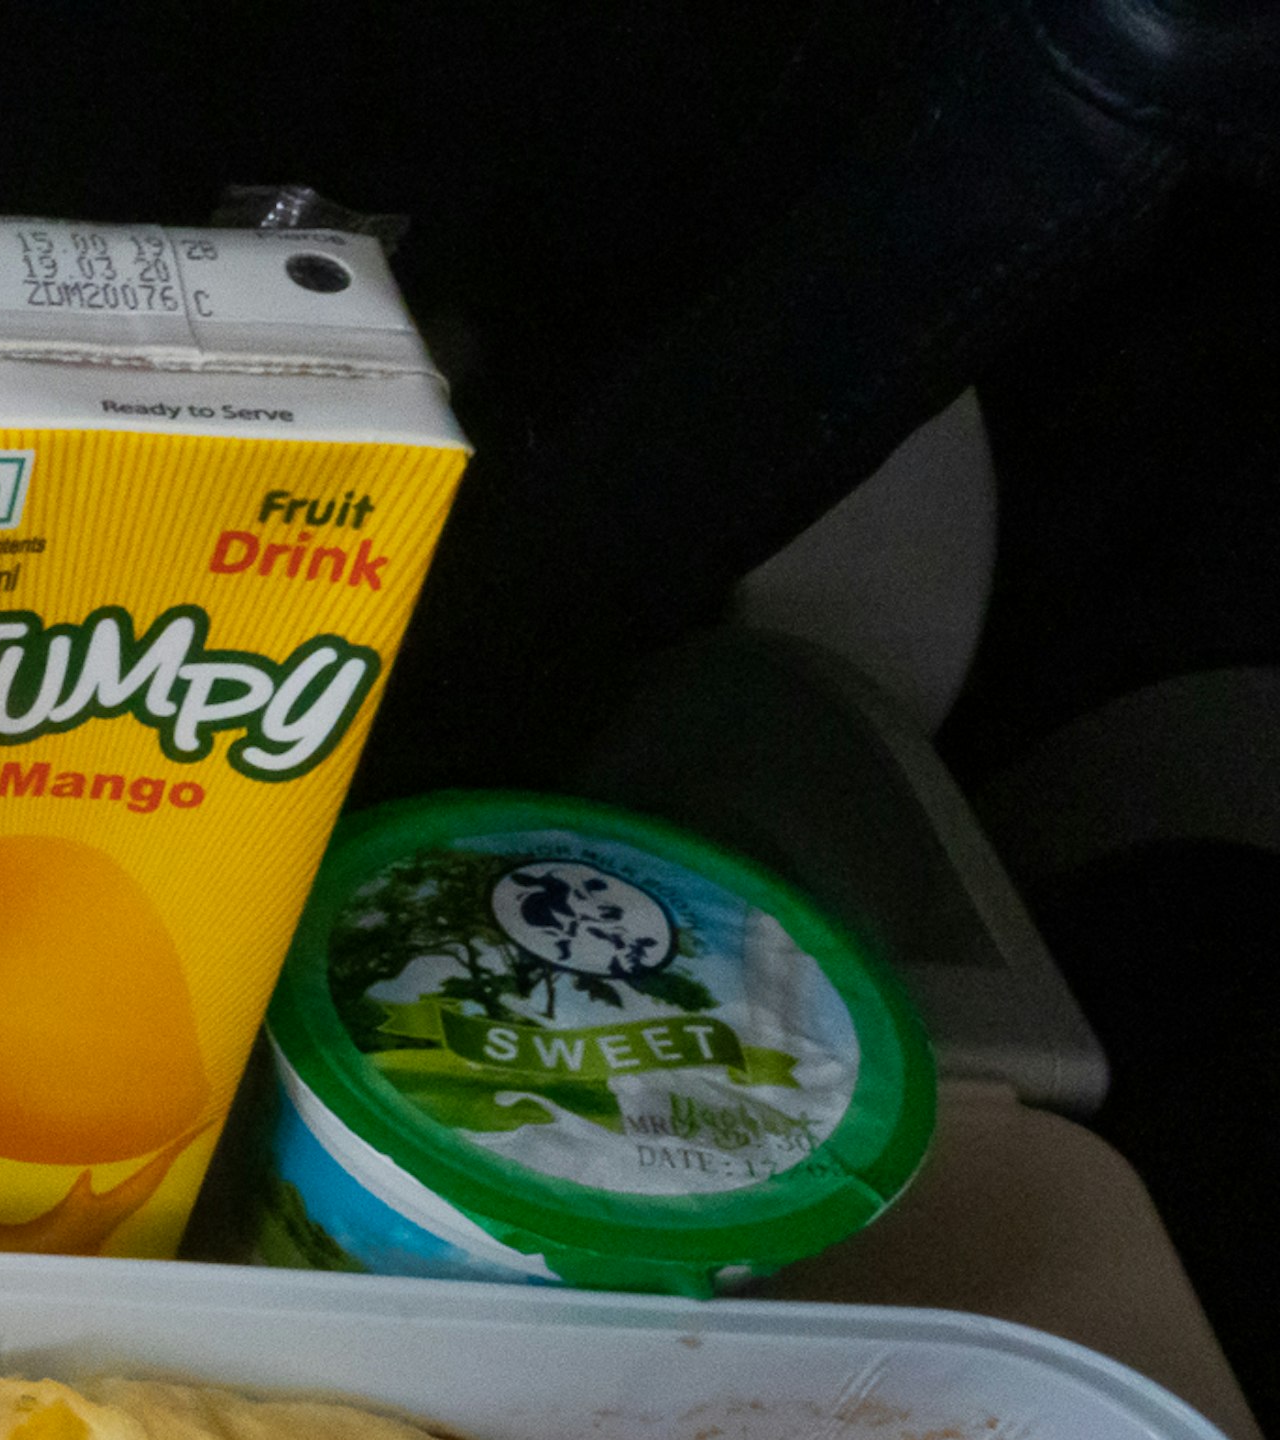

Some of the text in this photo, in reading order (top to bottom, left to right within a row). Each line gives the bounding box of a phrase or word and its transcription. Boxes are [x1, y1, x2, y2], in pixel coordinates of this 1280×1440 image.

[101, 399, 295, 422] Ready to Serve
[258, 490, 375, 529] Fruit
[208, 530, 389, 592] Drink
[483, 1024, 714, 1072] SWEET
